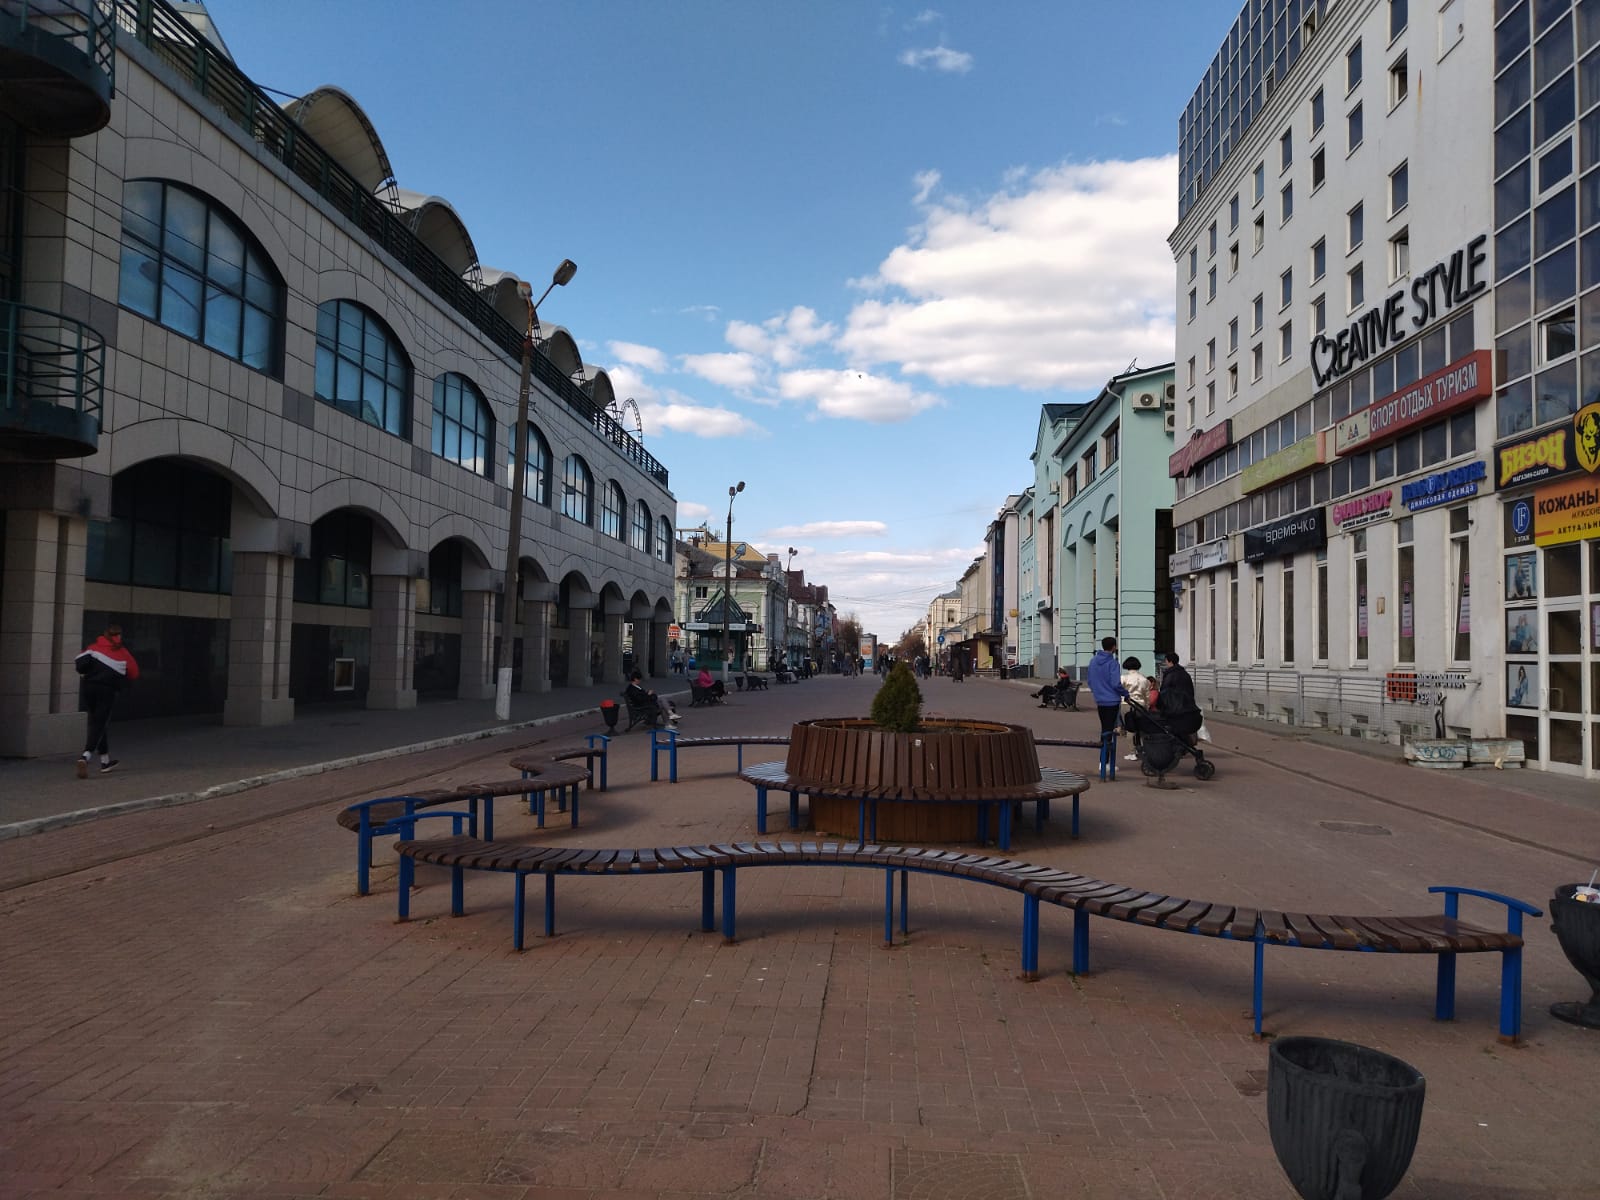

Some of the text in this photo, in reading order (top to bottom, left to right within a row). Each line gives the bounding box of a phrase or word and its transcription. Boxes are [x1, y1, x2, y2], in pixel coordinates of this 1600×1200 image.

[1311, 234, 1487, 387] CREATIVE STYLE
[1370, 361, 1478, 432] СПОРТ ОТДЫХ ТУРИЗМ
[1500, 430, 1566, 487] БИЗОН
[1512, 468, 1549, 483] МАГАЗИН-САЛОН
[1448, 485, 1474, 499] одежда
[1538, 488, 1599, 516] КОЖАНЫ
[1266, 518, 1316, 544] времечко
